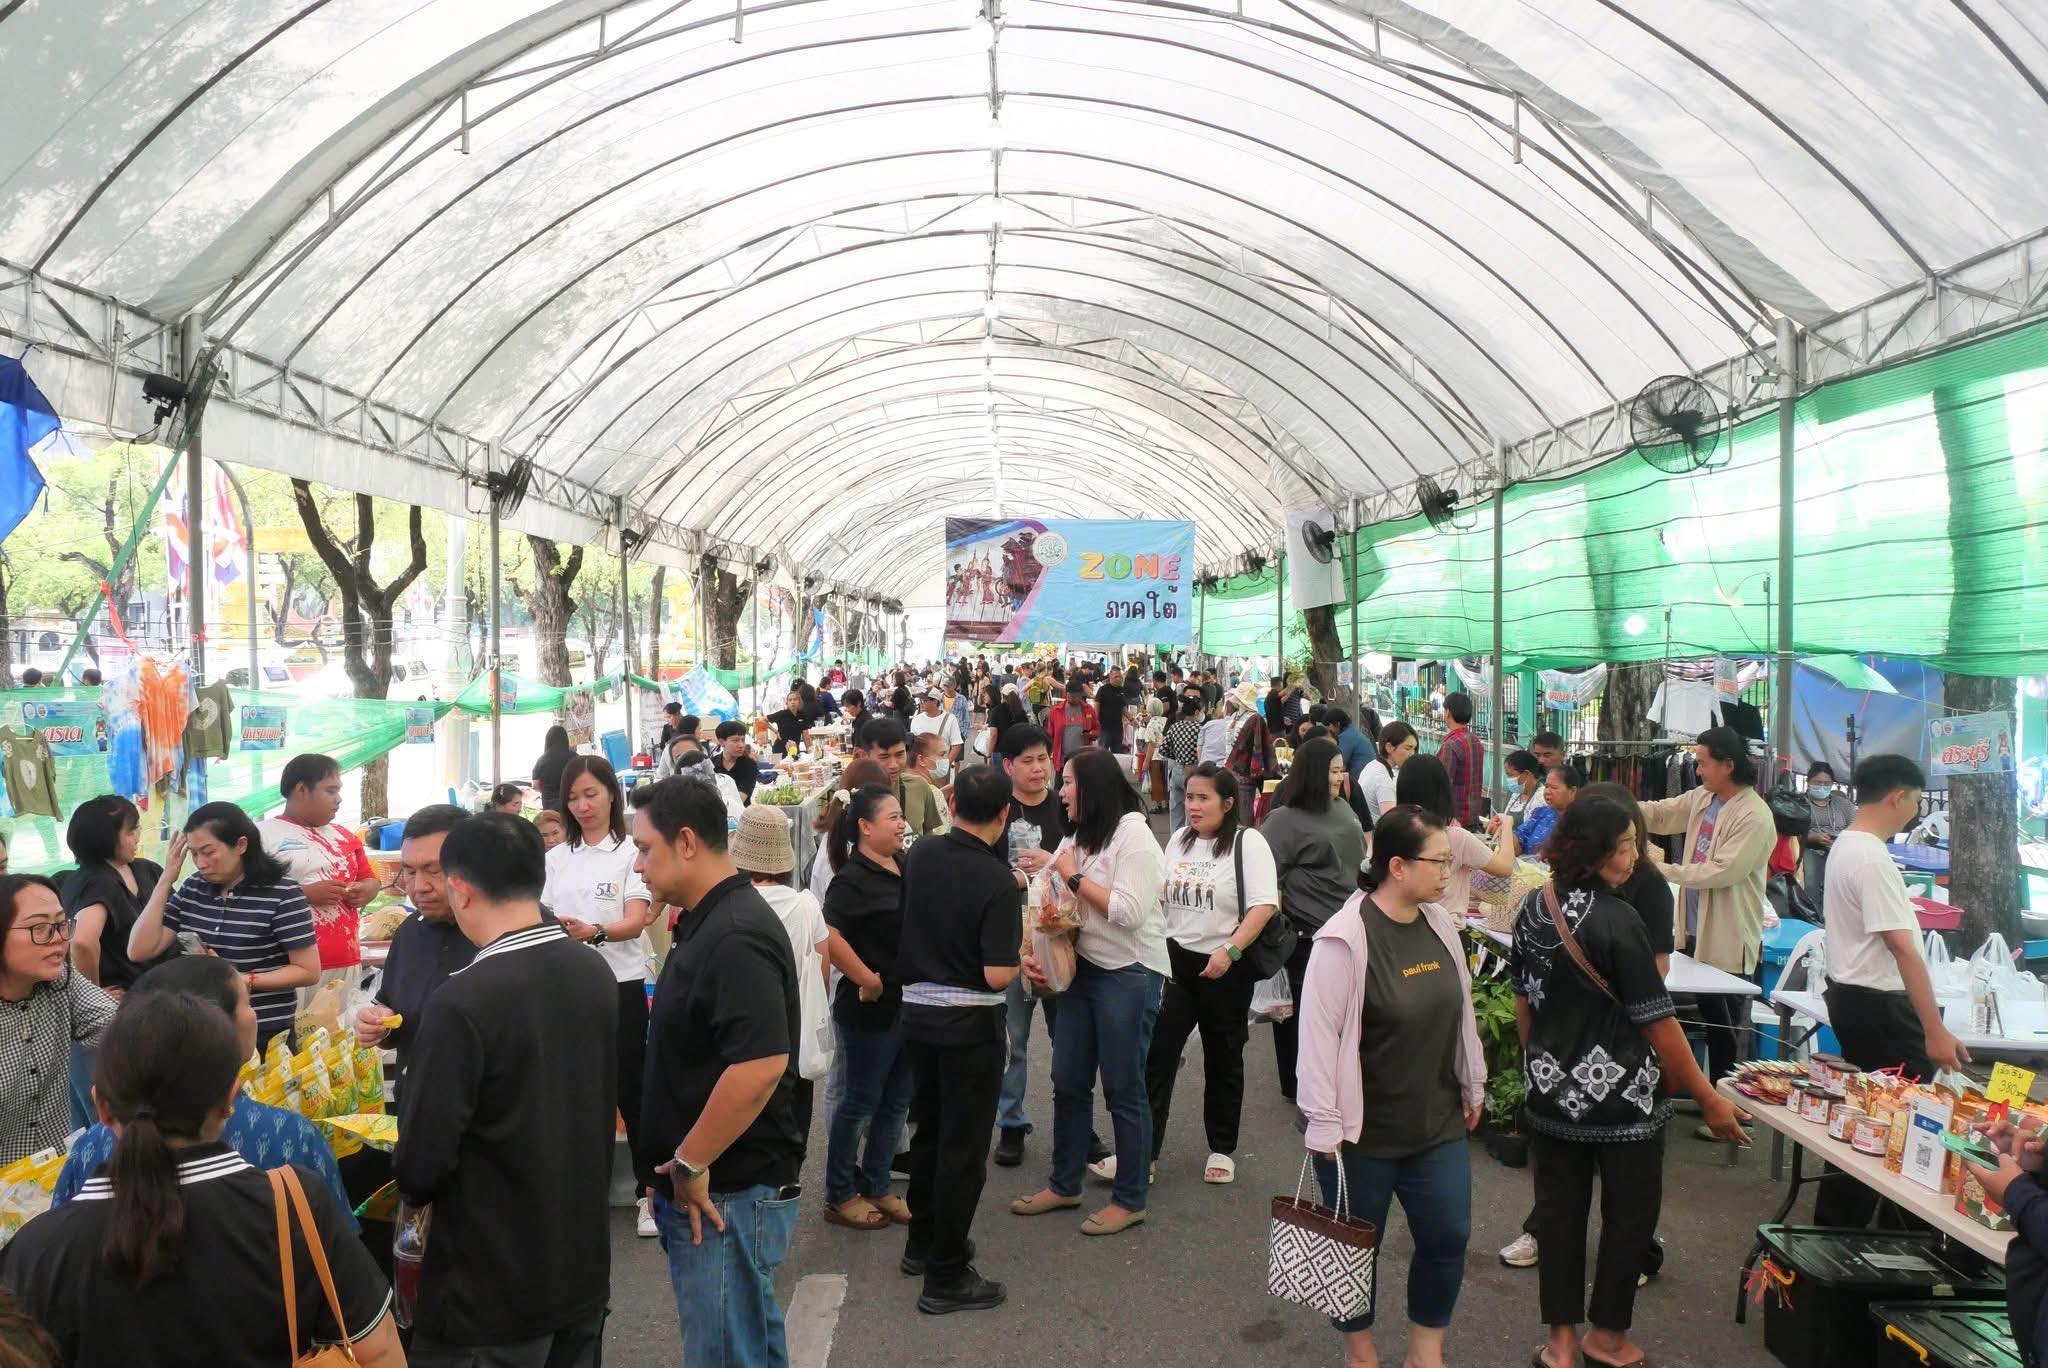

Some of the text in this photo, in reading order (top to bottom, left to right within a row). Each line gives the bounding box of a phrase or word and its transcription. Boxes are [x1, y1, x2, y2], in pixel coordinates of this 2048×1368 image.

[1080, 551, 1181, 581] ZONE
[1105, 585, 1178, 619] ภาคใต้
[1942, 736, 1992, 771] สระบุรี
[1402, 960, 1441, 978] paul frank
